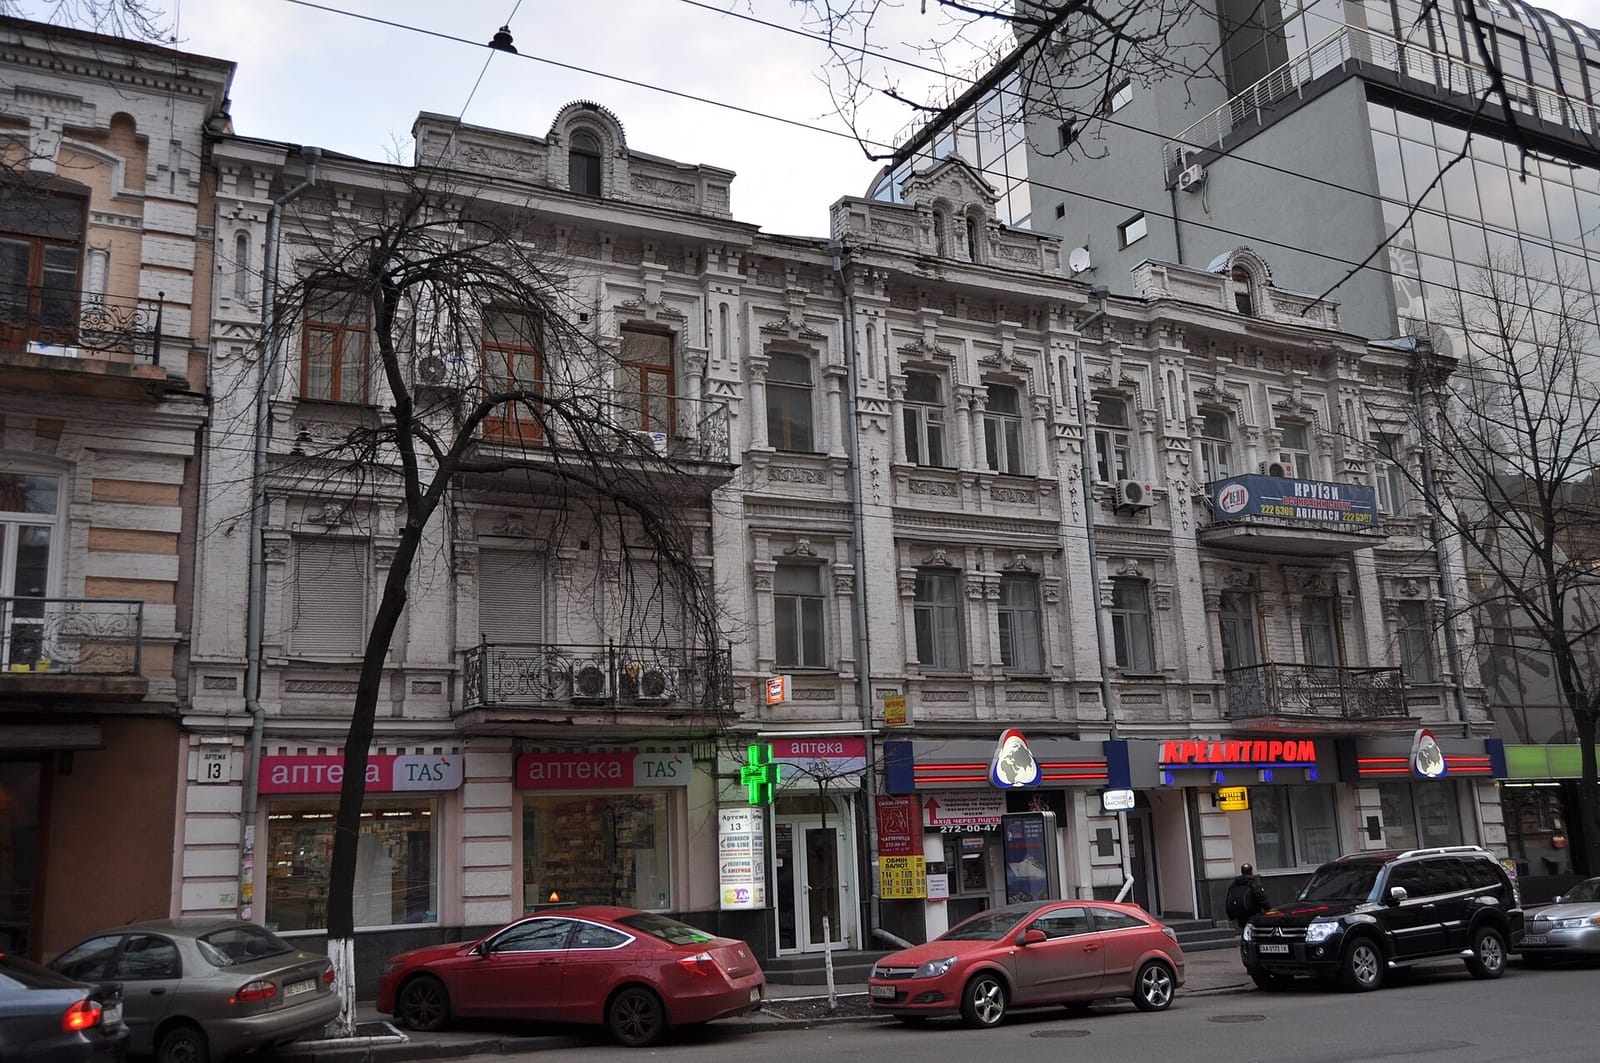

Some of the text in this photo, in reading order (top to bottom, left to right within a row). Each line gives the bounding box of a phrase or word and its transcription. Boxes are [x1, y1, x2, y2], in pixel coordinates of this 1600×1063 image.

[1295, 482, 1339, 500] КРУЇЗИ
[1296, 507, 1339, 520] АВІАКАСИ
[791, 742, 843, 753] аптека
[1162, 740, 1317, 763] КРЕДИТПРОМ
[208, 763, 221, 779] 13
[271, 763, 443, 784] аптеа TAS
[529, 760, 676, 779] аптека TAS
[730, 823, 741, 831] 13
